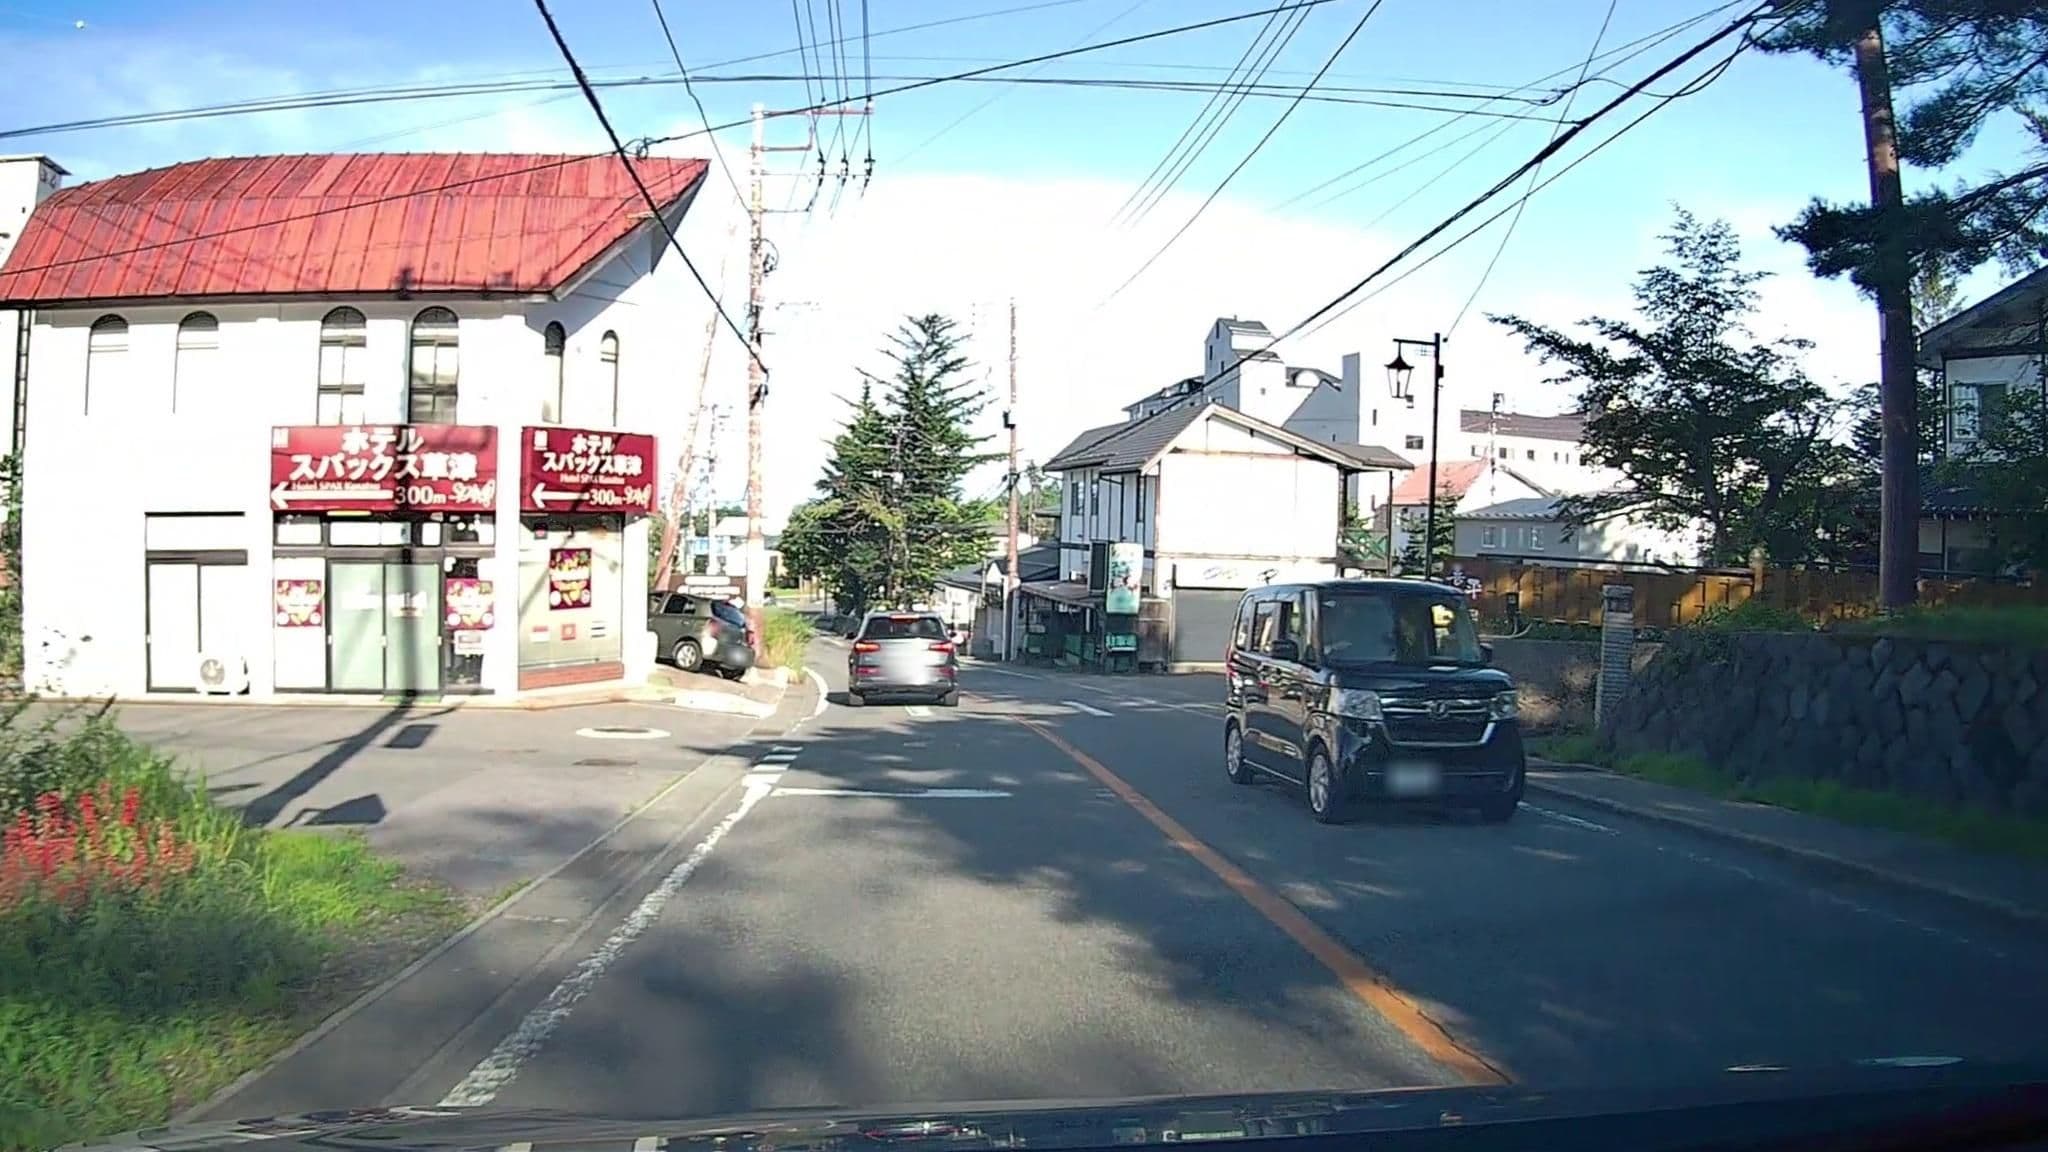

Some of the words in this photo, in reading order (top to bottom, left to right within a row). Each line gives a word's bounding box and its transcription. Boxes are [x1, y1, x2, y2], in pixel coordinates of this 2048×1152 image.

[342, 427, 424, 454] ホテル
[571, 433, 615, 455] ホテル
[395, 485, 446, 505] 300m
